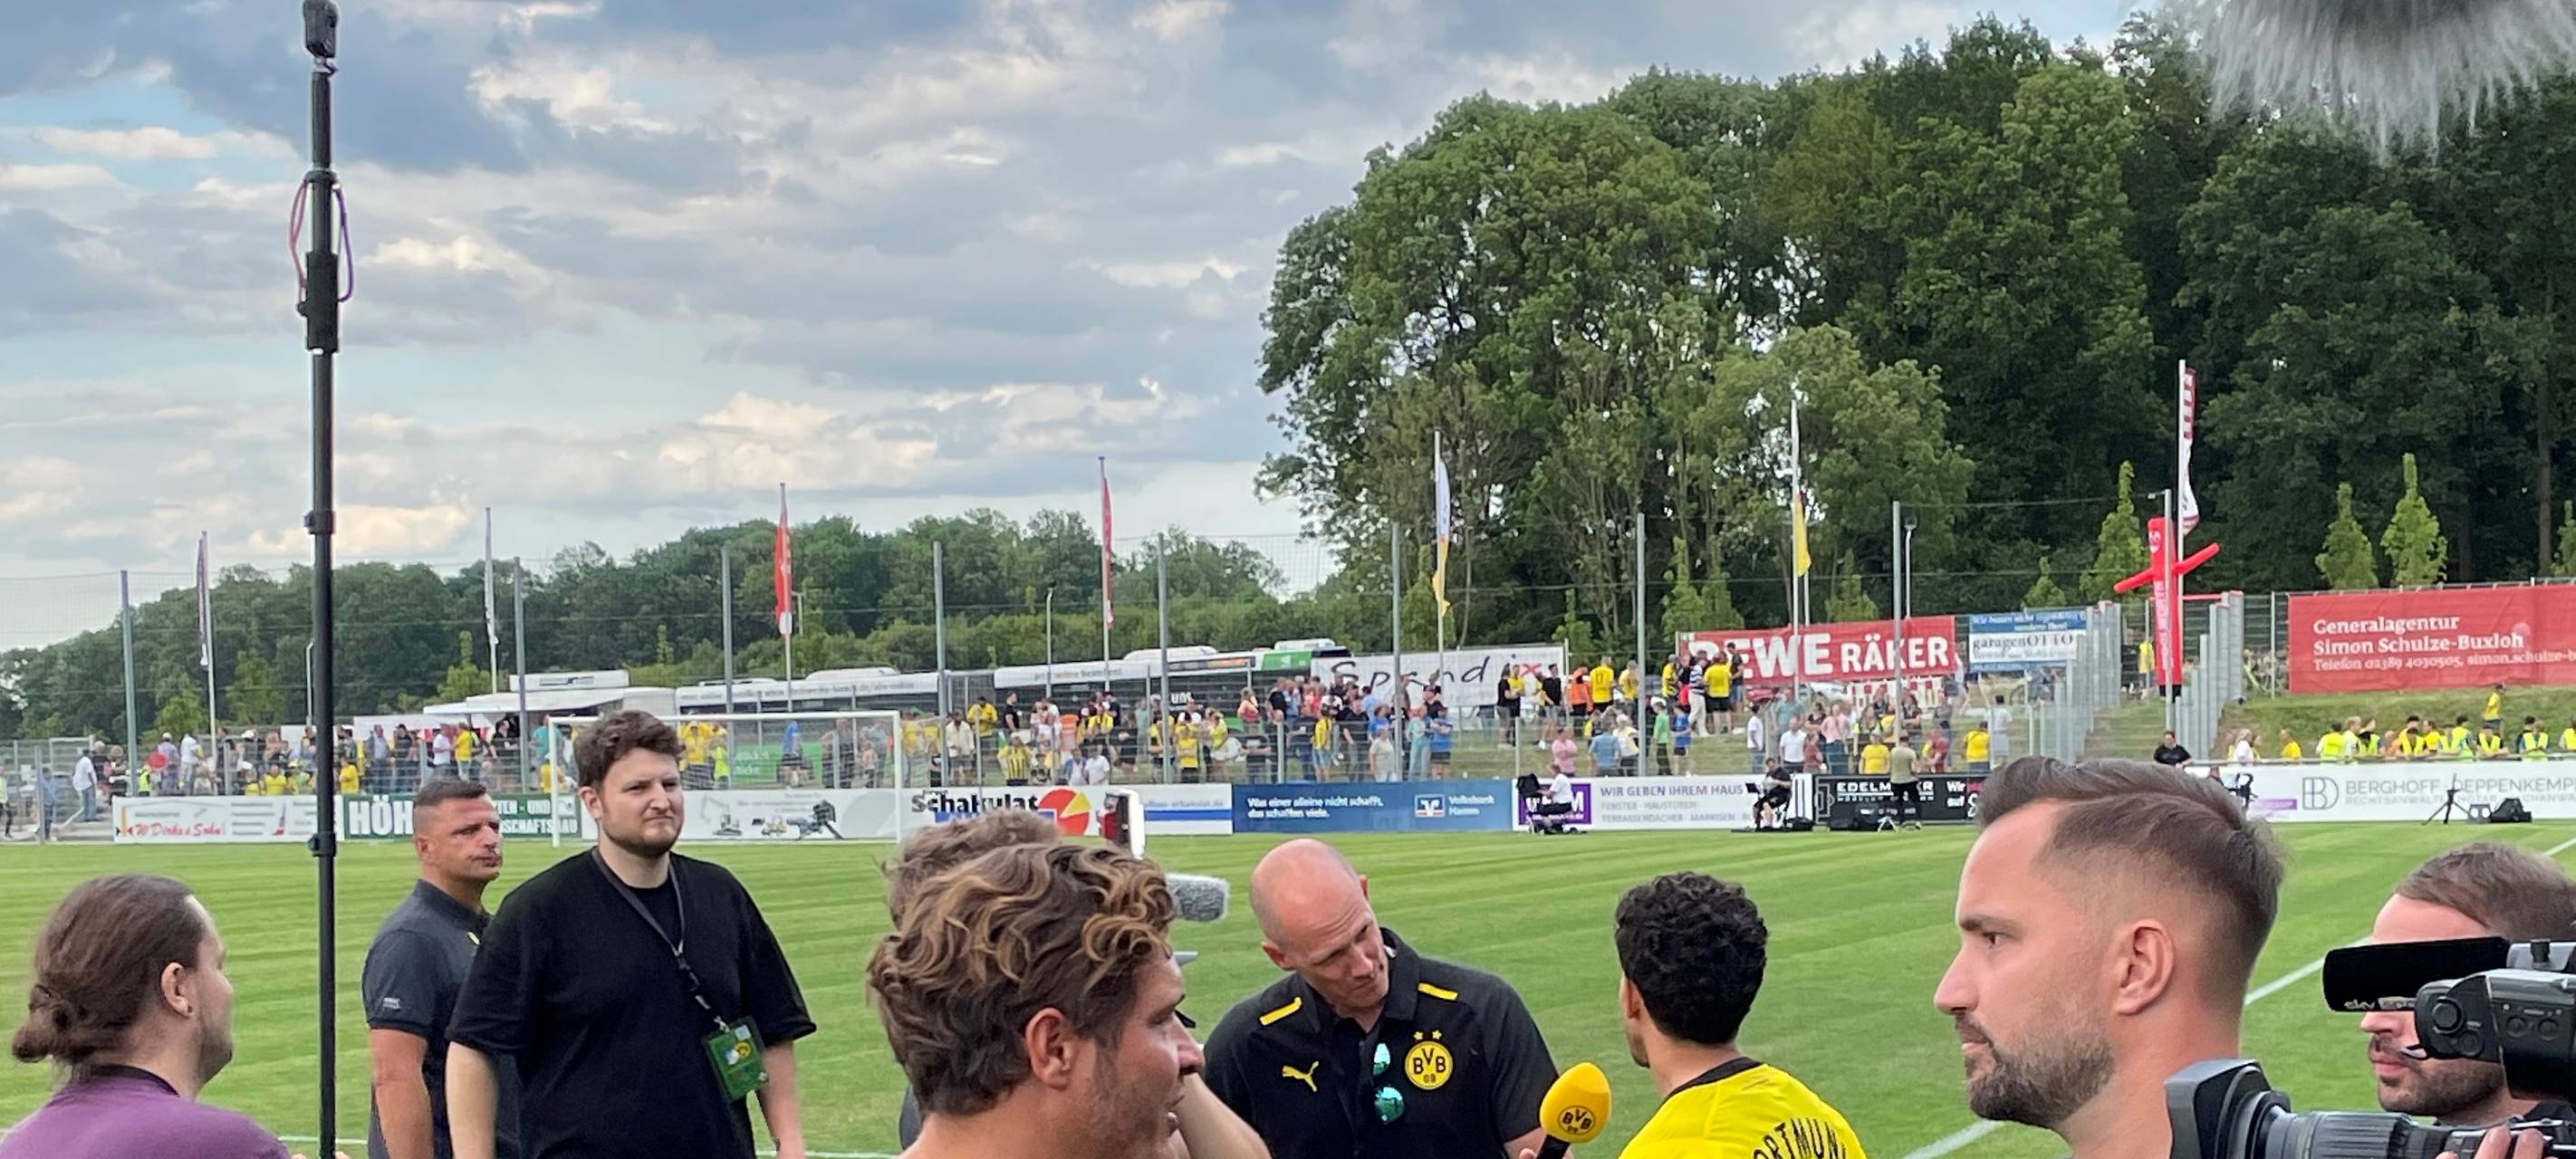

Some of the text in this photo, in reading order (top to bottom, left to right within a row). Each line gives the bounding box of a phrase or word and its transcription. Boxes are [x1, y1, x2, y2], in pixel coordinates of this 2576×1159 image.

[2313, 617, 2460, 635] Generalagentur
[1841, 633, 1949, 673] RÄKER
[2313, 633, 2524, 655] Simon Schulze-Buxloh
[2313, 657, 2362, 671] Telefon
[1600, 787, 1624, 797] WIR
[1627, 786, 1666, 796] GEBEN
[1668, 786, 1707, 796] IHREM
[1711, 785, 1744, 795] HAUS
[2345, 779, 2441, 794] BERGHOFF
[911, 793, 1040, 813] Schakulat
[1413, 1048, 1447, 1075] BVB
[1562, 1108, 1592, 1130] BVB
